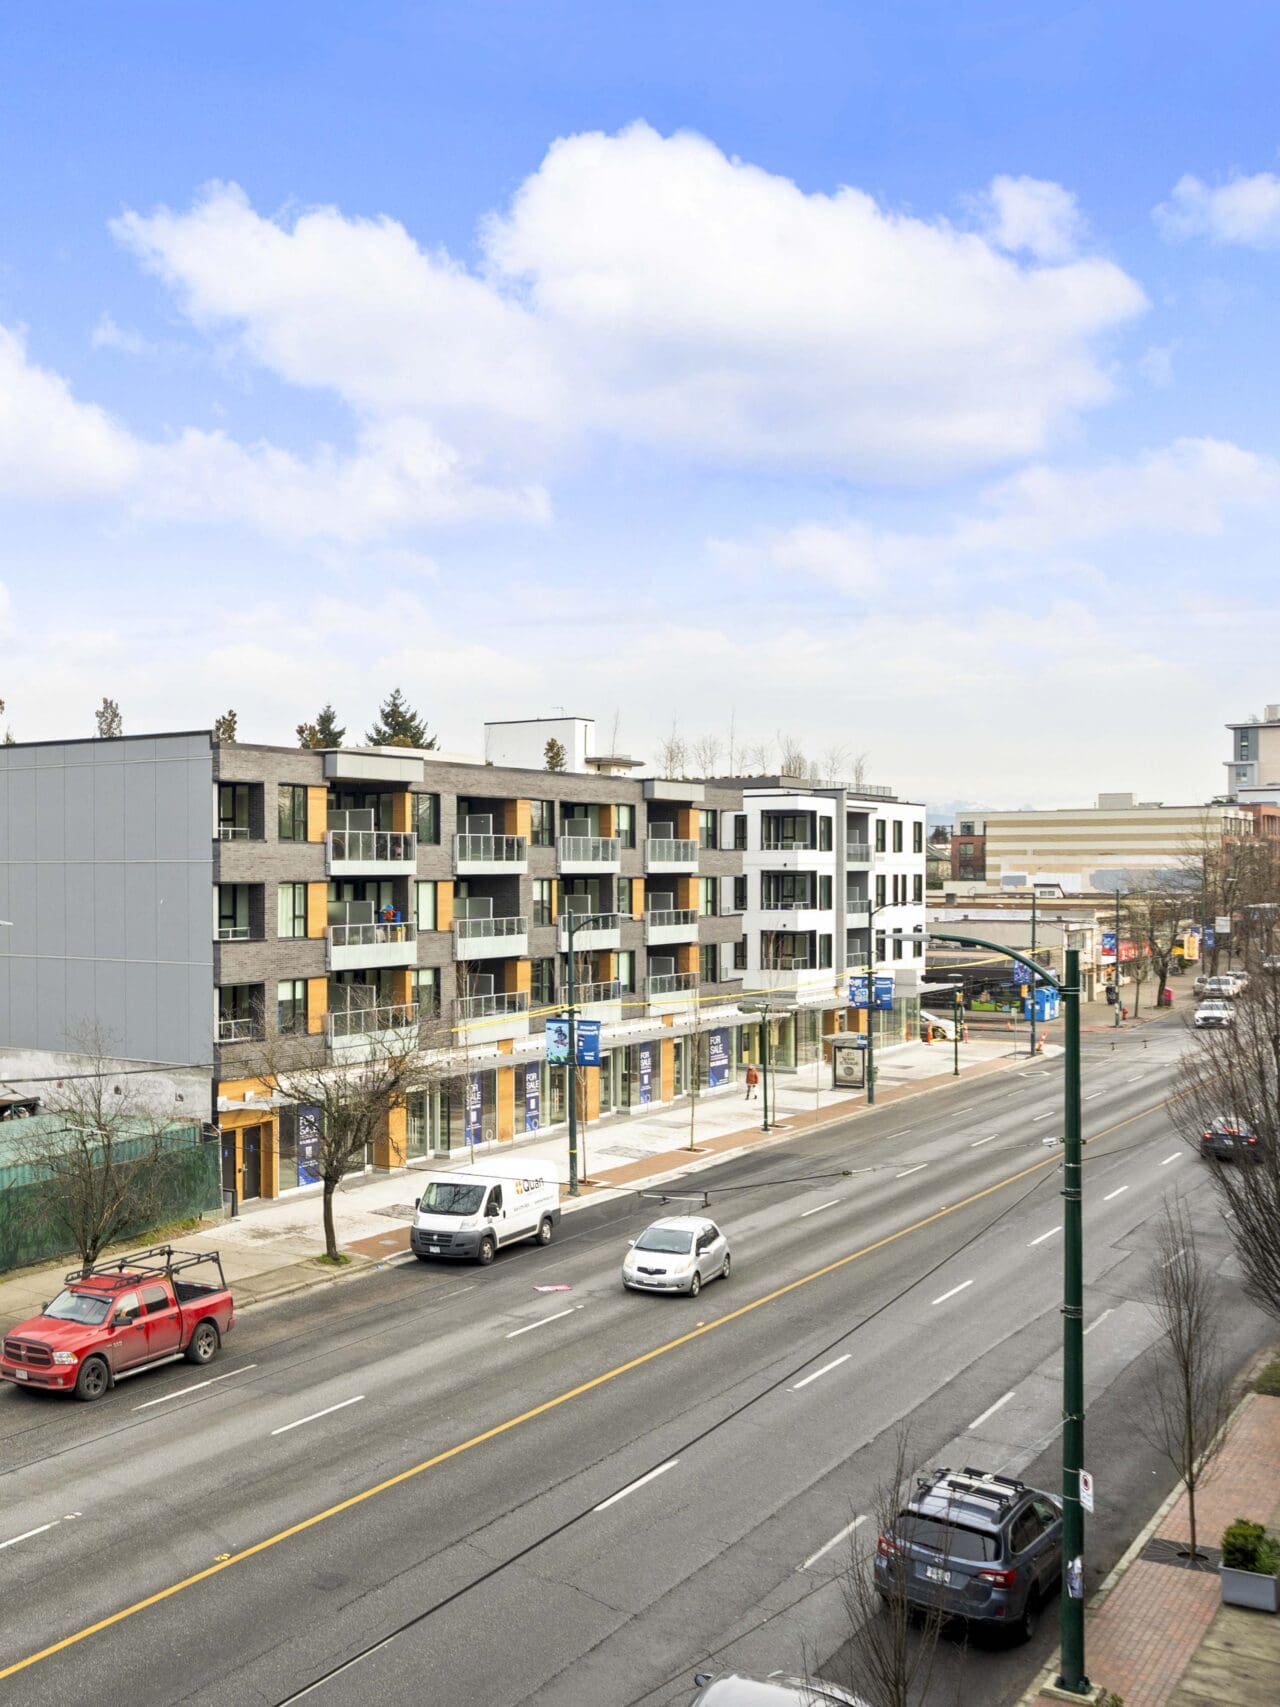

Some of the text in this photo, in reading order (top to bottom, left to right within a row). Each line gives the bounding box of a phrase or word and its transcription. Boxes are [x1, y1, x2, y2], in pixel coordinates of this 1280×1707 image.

[710, 1036, 721, 1045] FOR
[710, 1044, 724, 1055] SALE
[640, 1051, 650, 1060] FOR
[640, 1058, 651, 1067] SALE
[526, 1073, 537, 1082] FOR
[526, 1080, 540, 1090] SALE
